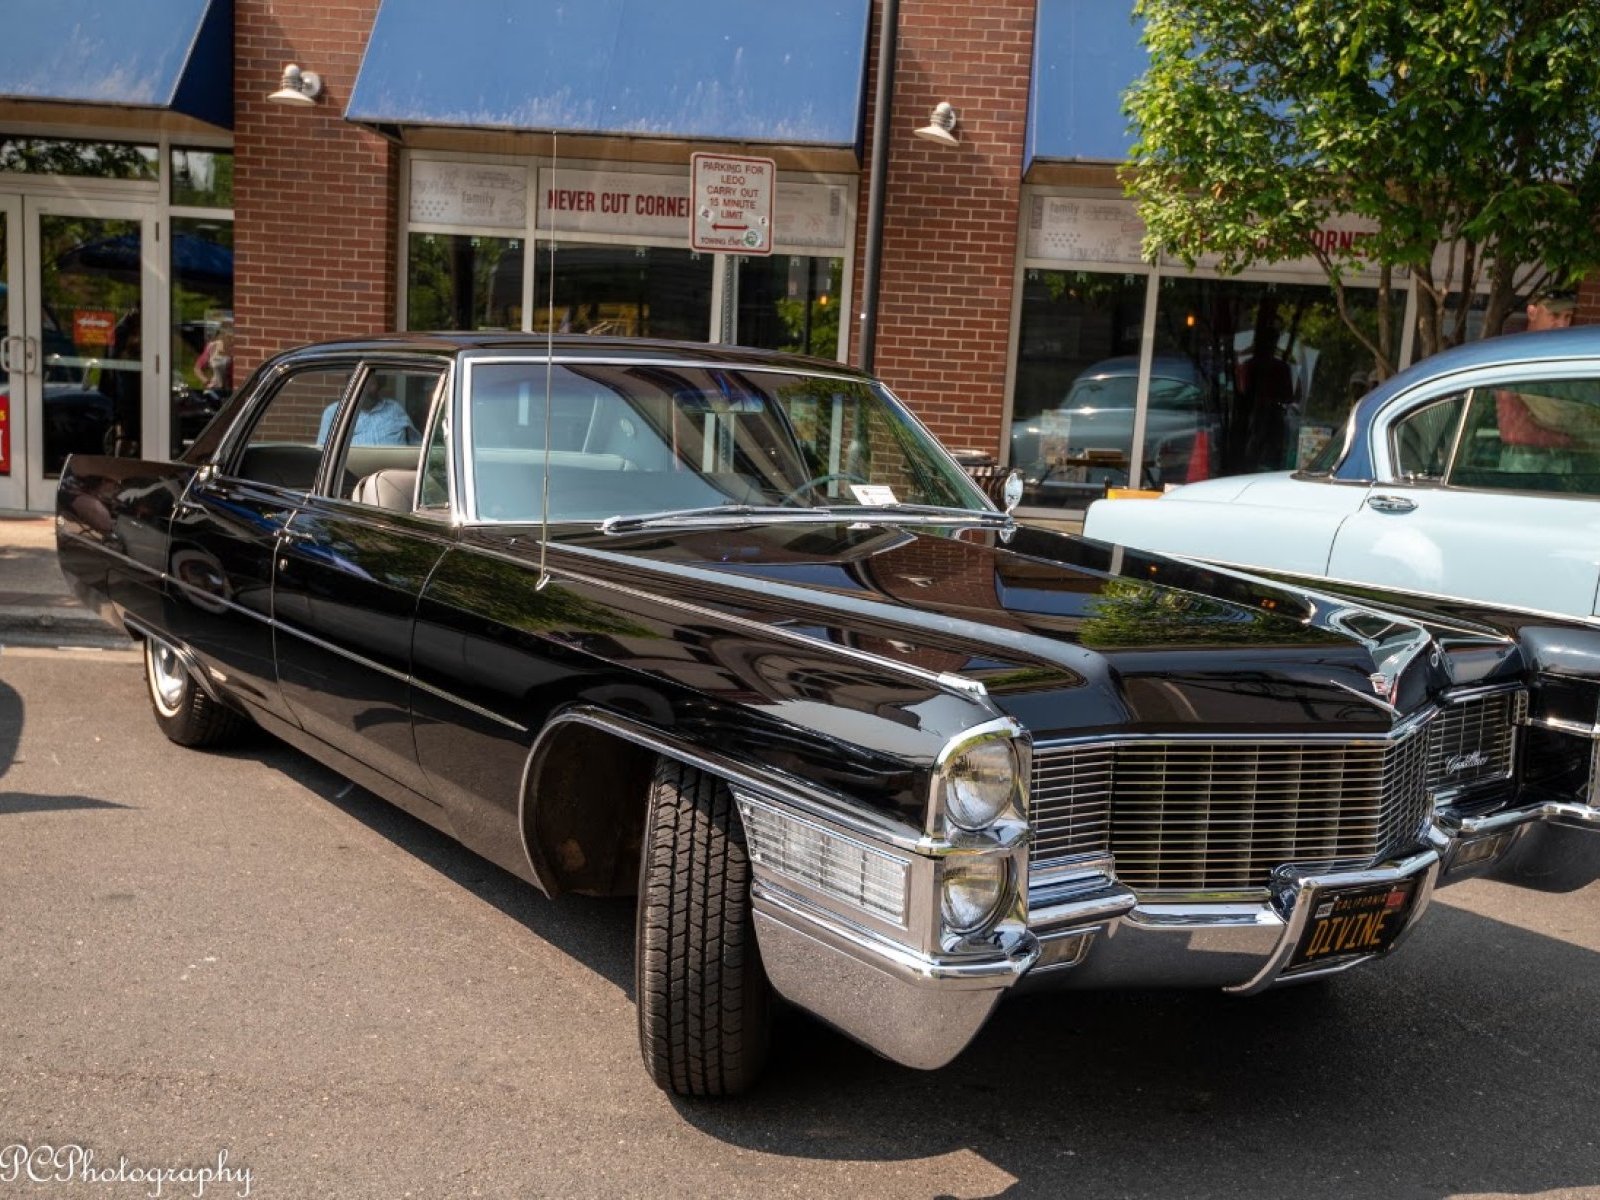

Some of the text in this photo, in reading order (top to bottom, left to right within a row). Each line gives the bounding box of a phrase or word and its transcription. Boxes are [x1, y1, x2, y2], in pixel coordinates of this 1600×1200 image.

[703, 162, 764, 175] PARKING FOR
[720, 176, 746, 185] LEDO
[706, 186, 759, 198] CARRY OUT
[462, 191, 496, 208] family
[548, 189, 596, 212] NEVER
[601, 192, 630, 214] CUT
[722, 200, 757, 210] MINUTE
[720, 212, 744, 220] LIMIT
[701, 238, 726, 246] TOWING
[1305, 909, 1393, 957] DIVINE
